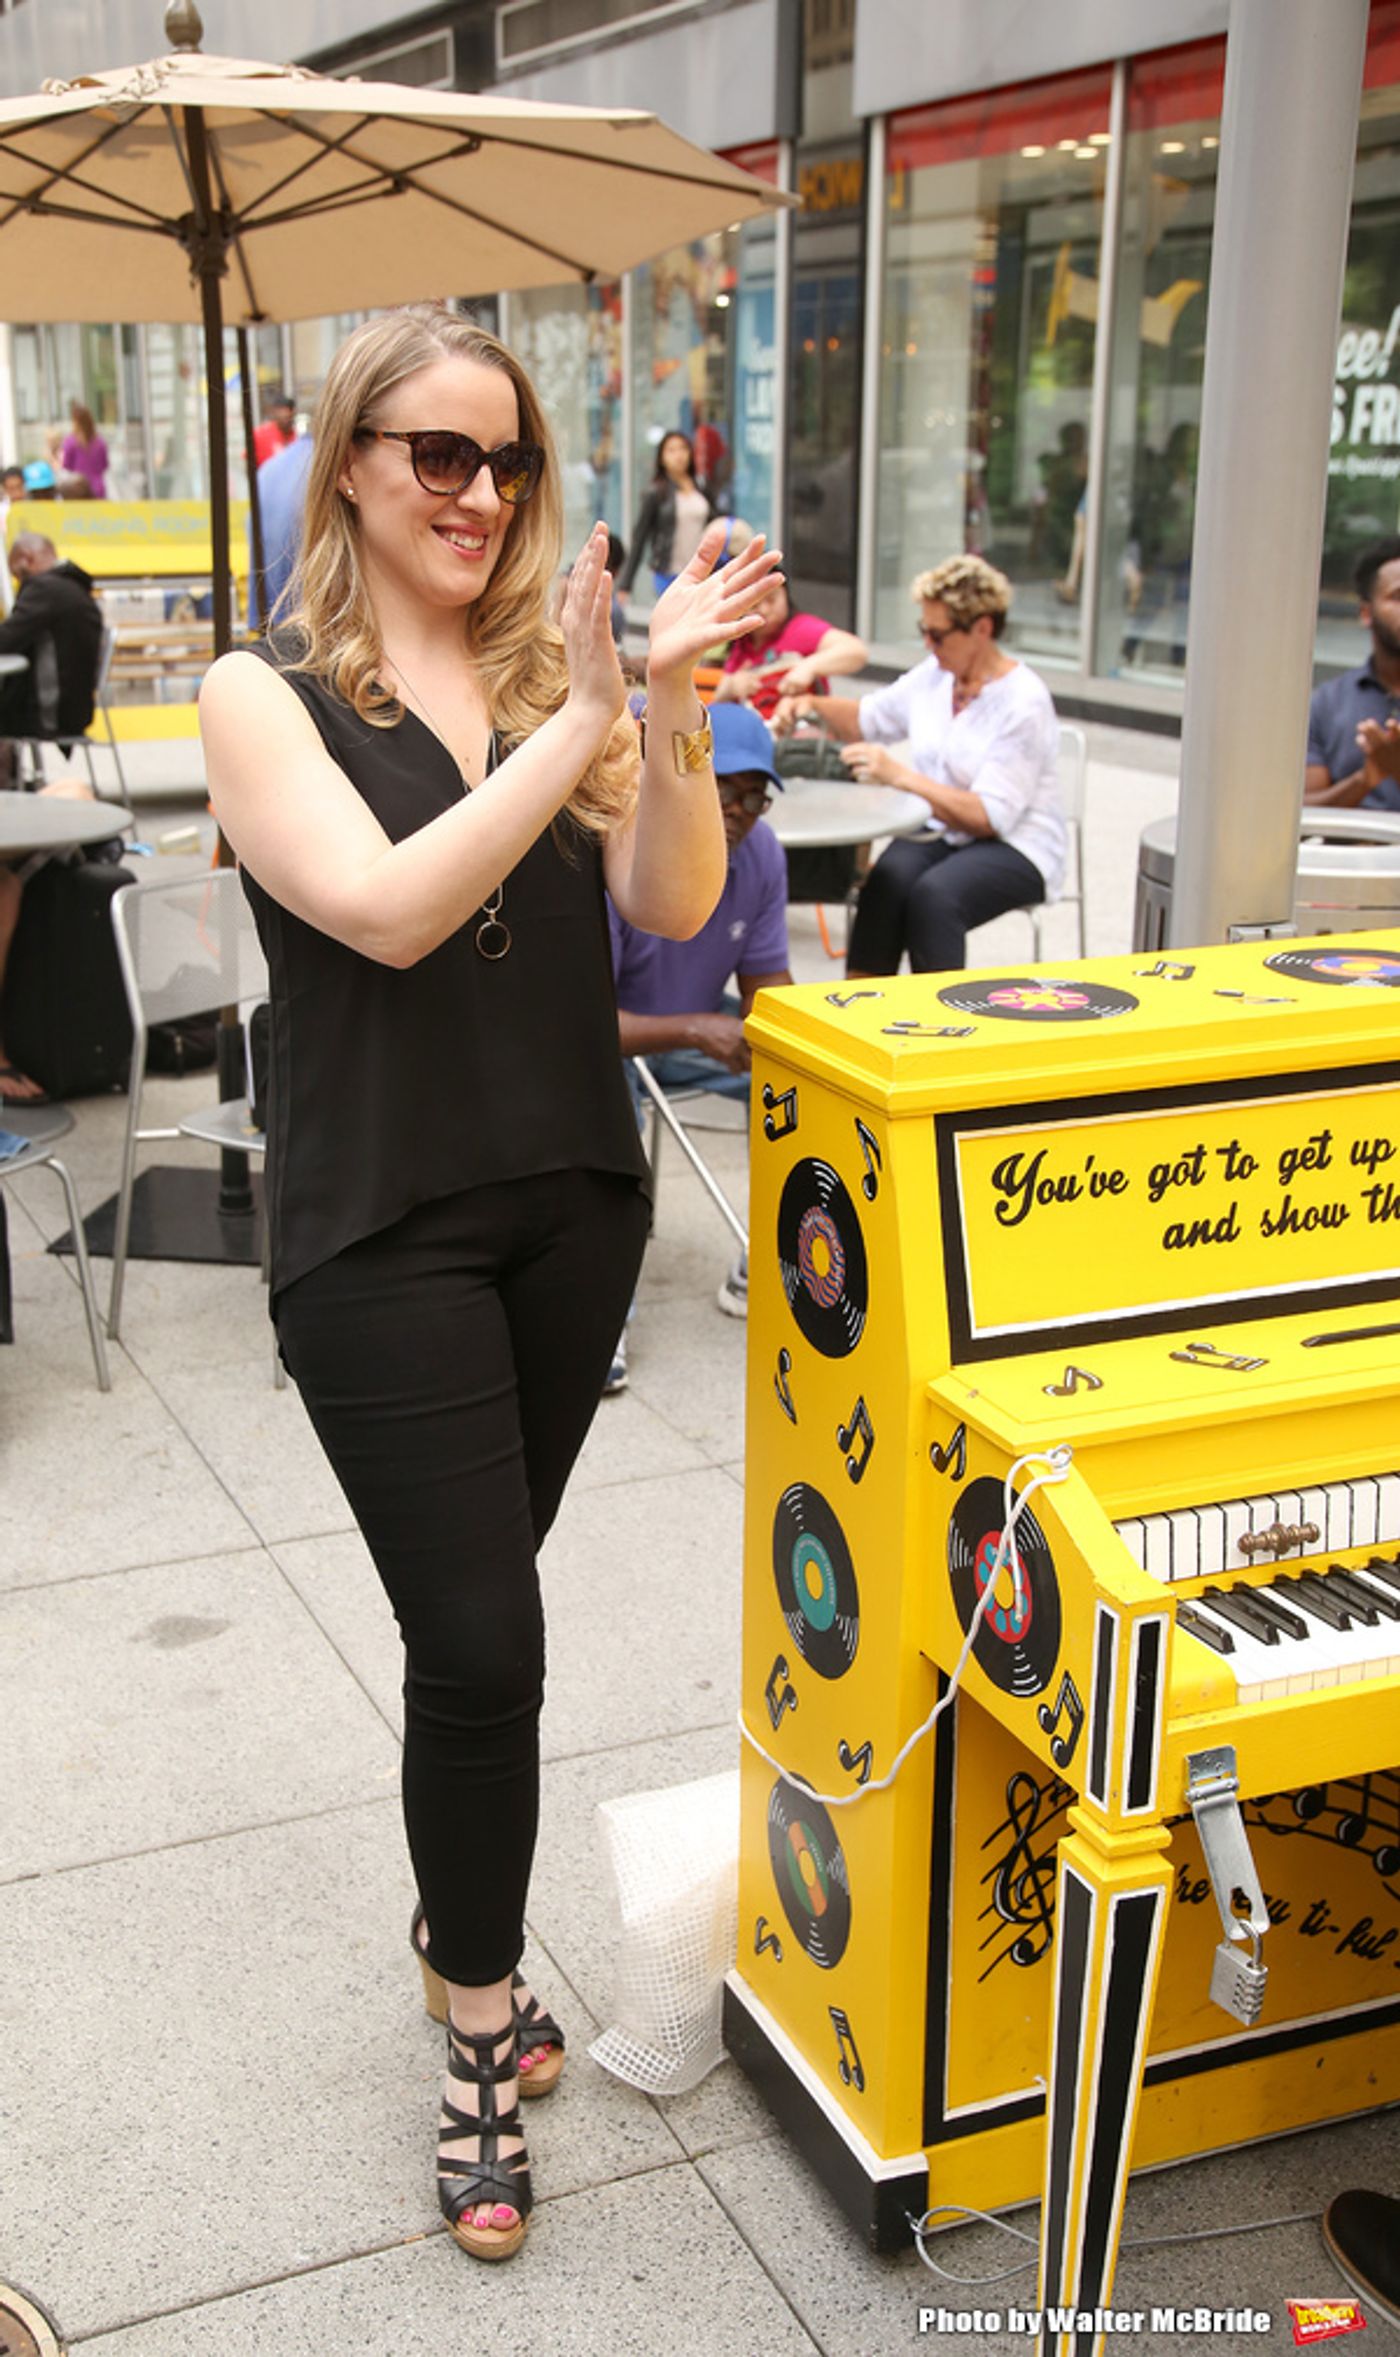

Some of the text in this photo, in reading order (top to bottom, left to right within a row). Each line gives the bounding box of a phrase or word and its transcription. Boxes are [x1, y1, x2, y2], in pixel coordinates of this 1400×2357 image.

[1335, 304, 1400, 381] ee!
[991, 1129, 1397, 1227] You've got to get up
[1162, 1182, 1400, 1251] and show th
[1175, 1863, 1212, 1905] 're
